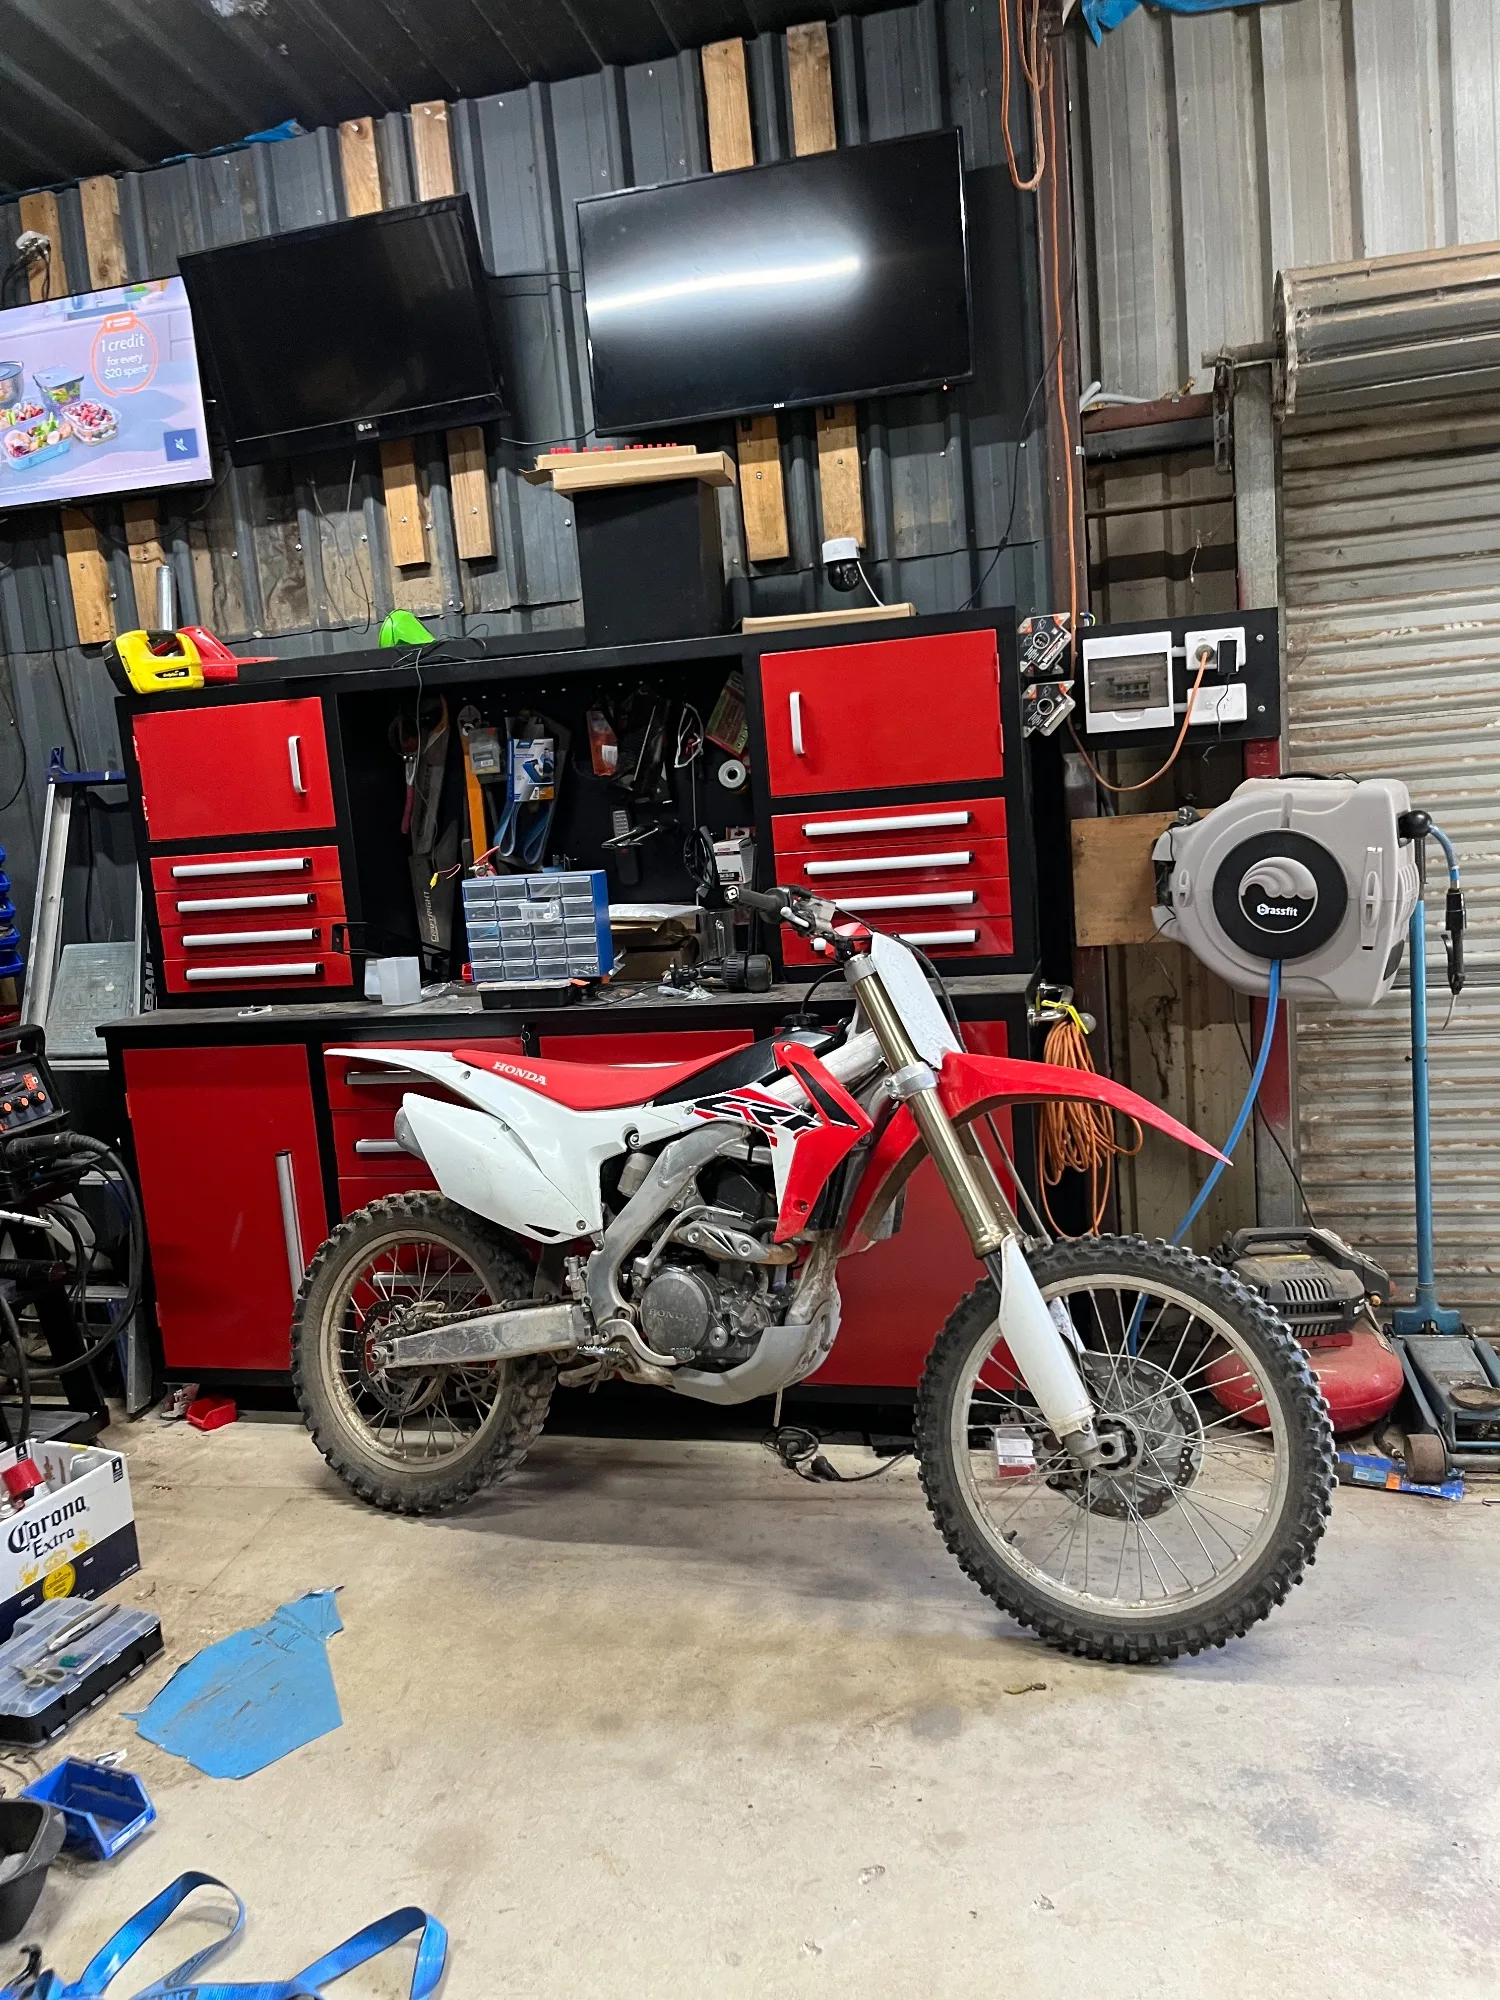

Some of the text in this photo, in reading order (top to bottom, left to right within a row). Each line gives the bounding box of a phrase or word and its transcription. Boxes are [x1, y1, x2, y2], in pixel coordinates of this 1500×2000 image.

[101, 333, 145, 353] 1 credit
[107, 354, 143, 366] for every
[105, 367, 122, 379] $20
[1257, 903, 1298, 917] Brassfit
[492, 1061, 547, 1086] HONDA
[8, 1496, 86, 1553] Corona
[33, 1528, 75, 1559] Extra
